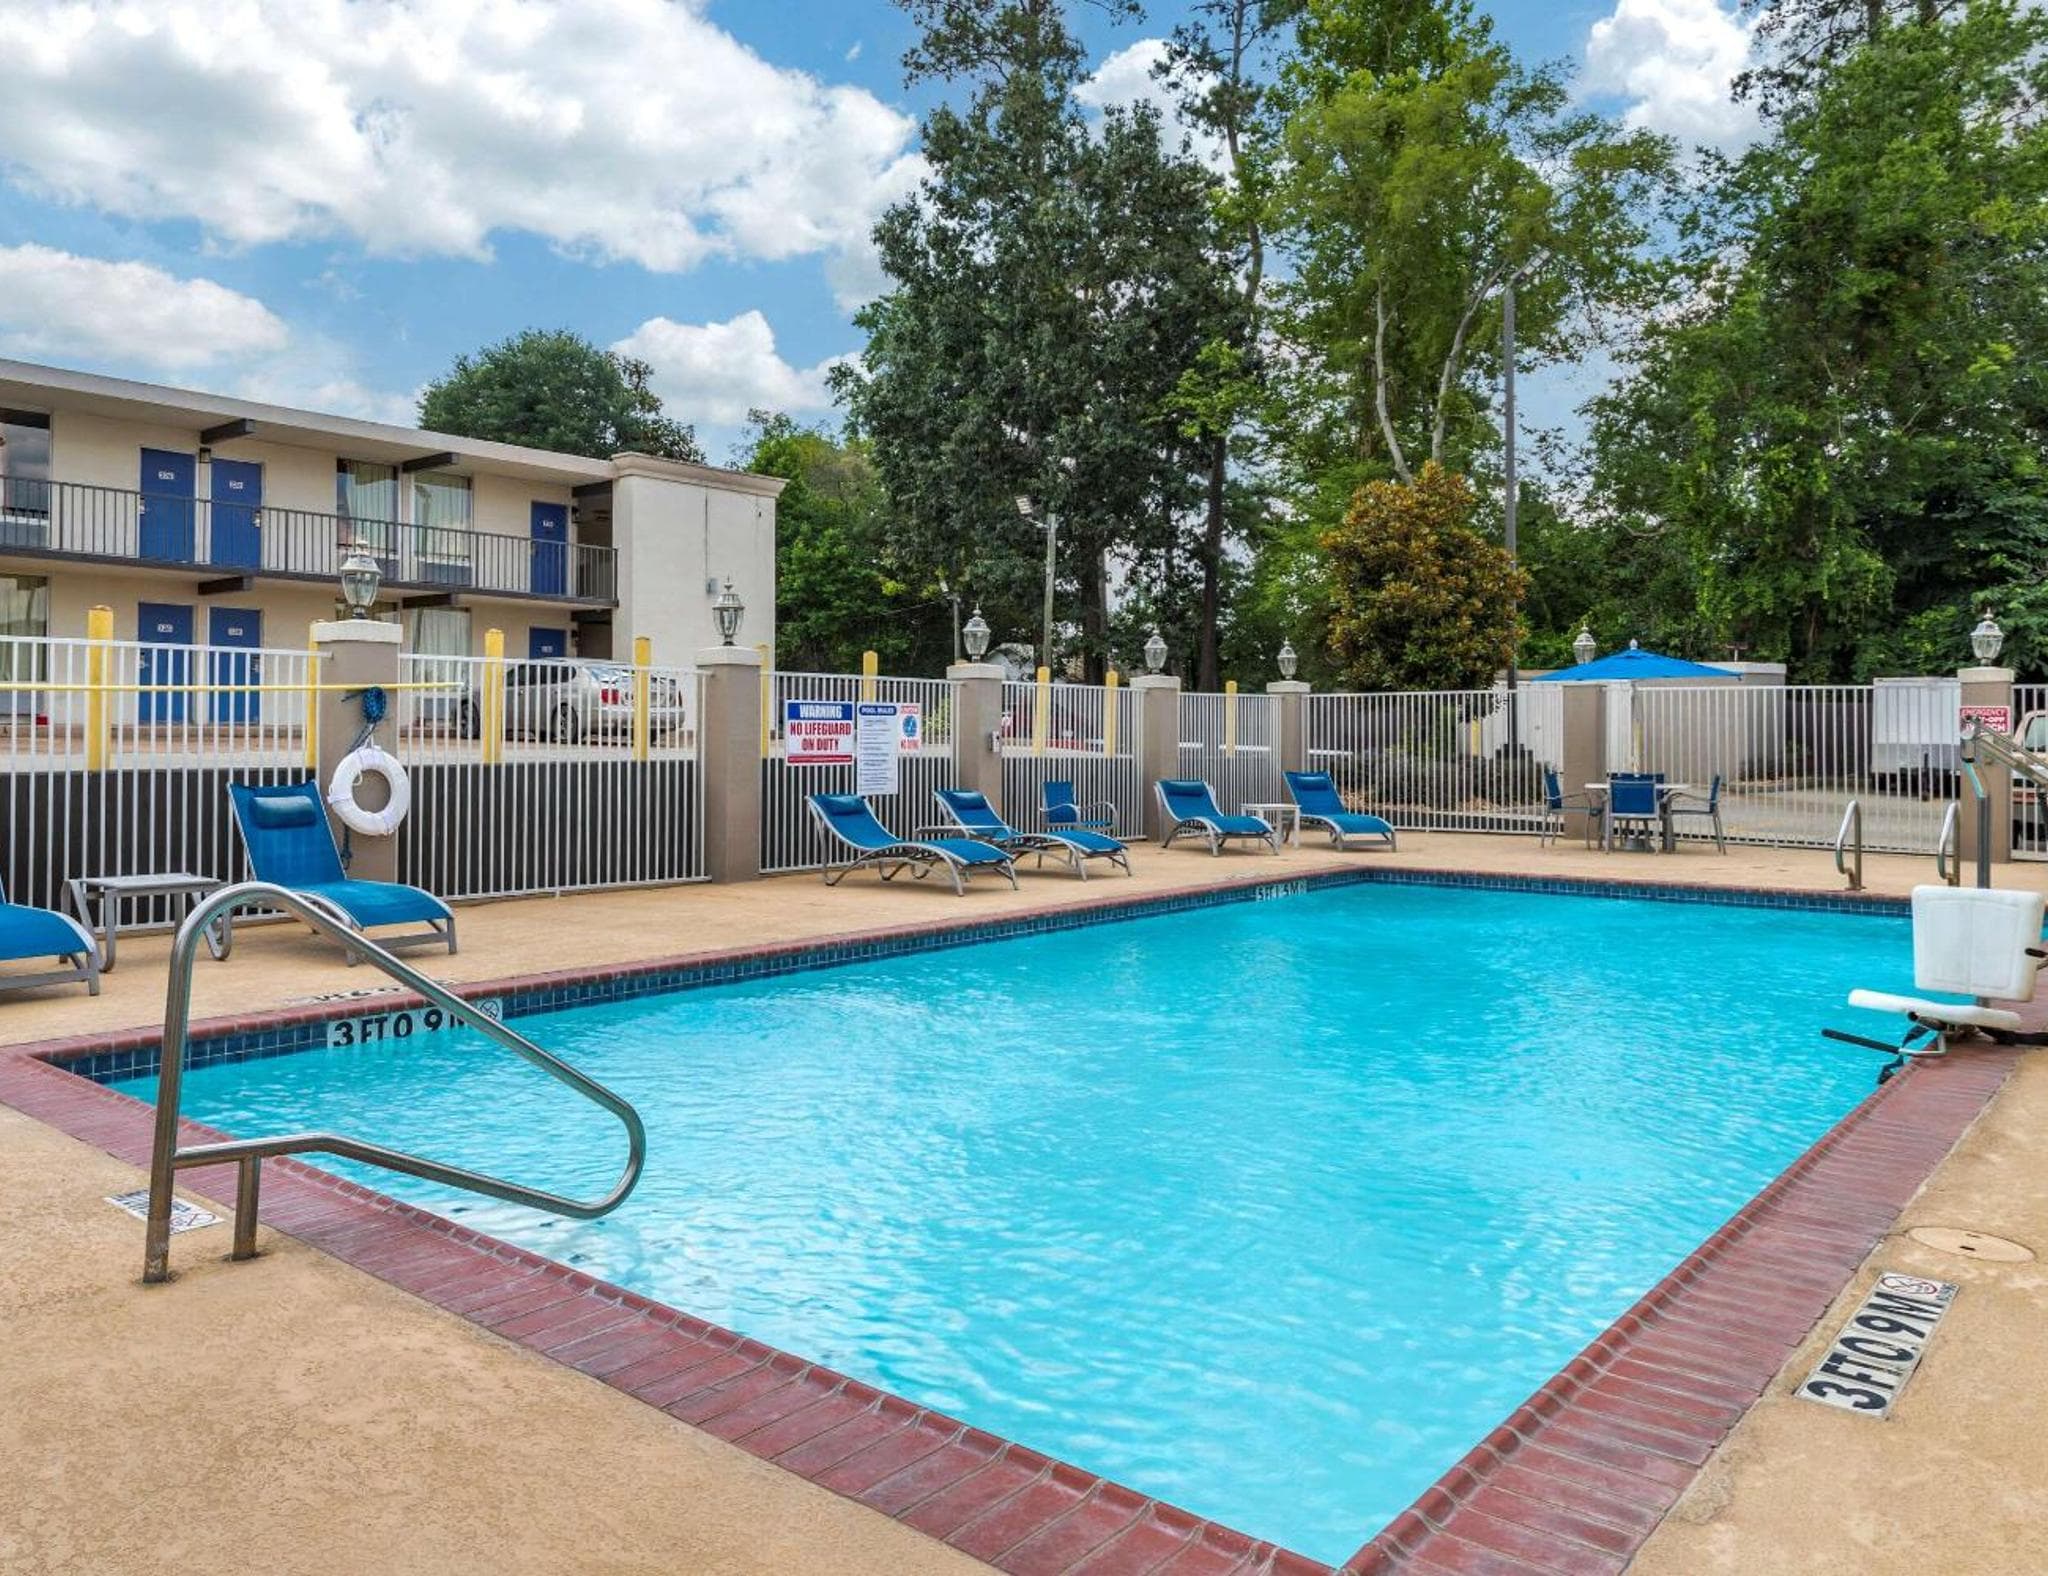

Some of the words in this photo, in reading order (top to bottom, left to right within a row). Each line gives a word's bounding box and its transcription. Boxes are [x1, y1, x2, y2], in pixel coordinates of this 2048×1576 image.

[799, 704, 843, 718] WARNING
[790, 722, 802, 736] NO
[804, 722, 851, 736] LIFEGUARD
[801, 738, 814, 751] ON
[817, 738, 840, 751] DUTY
